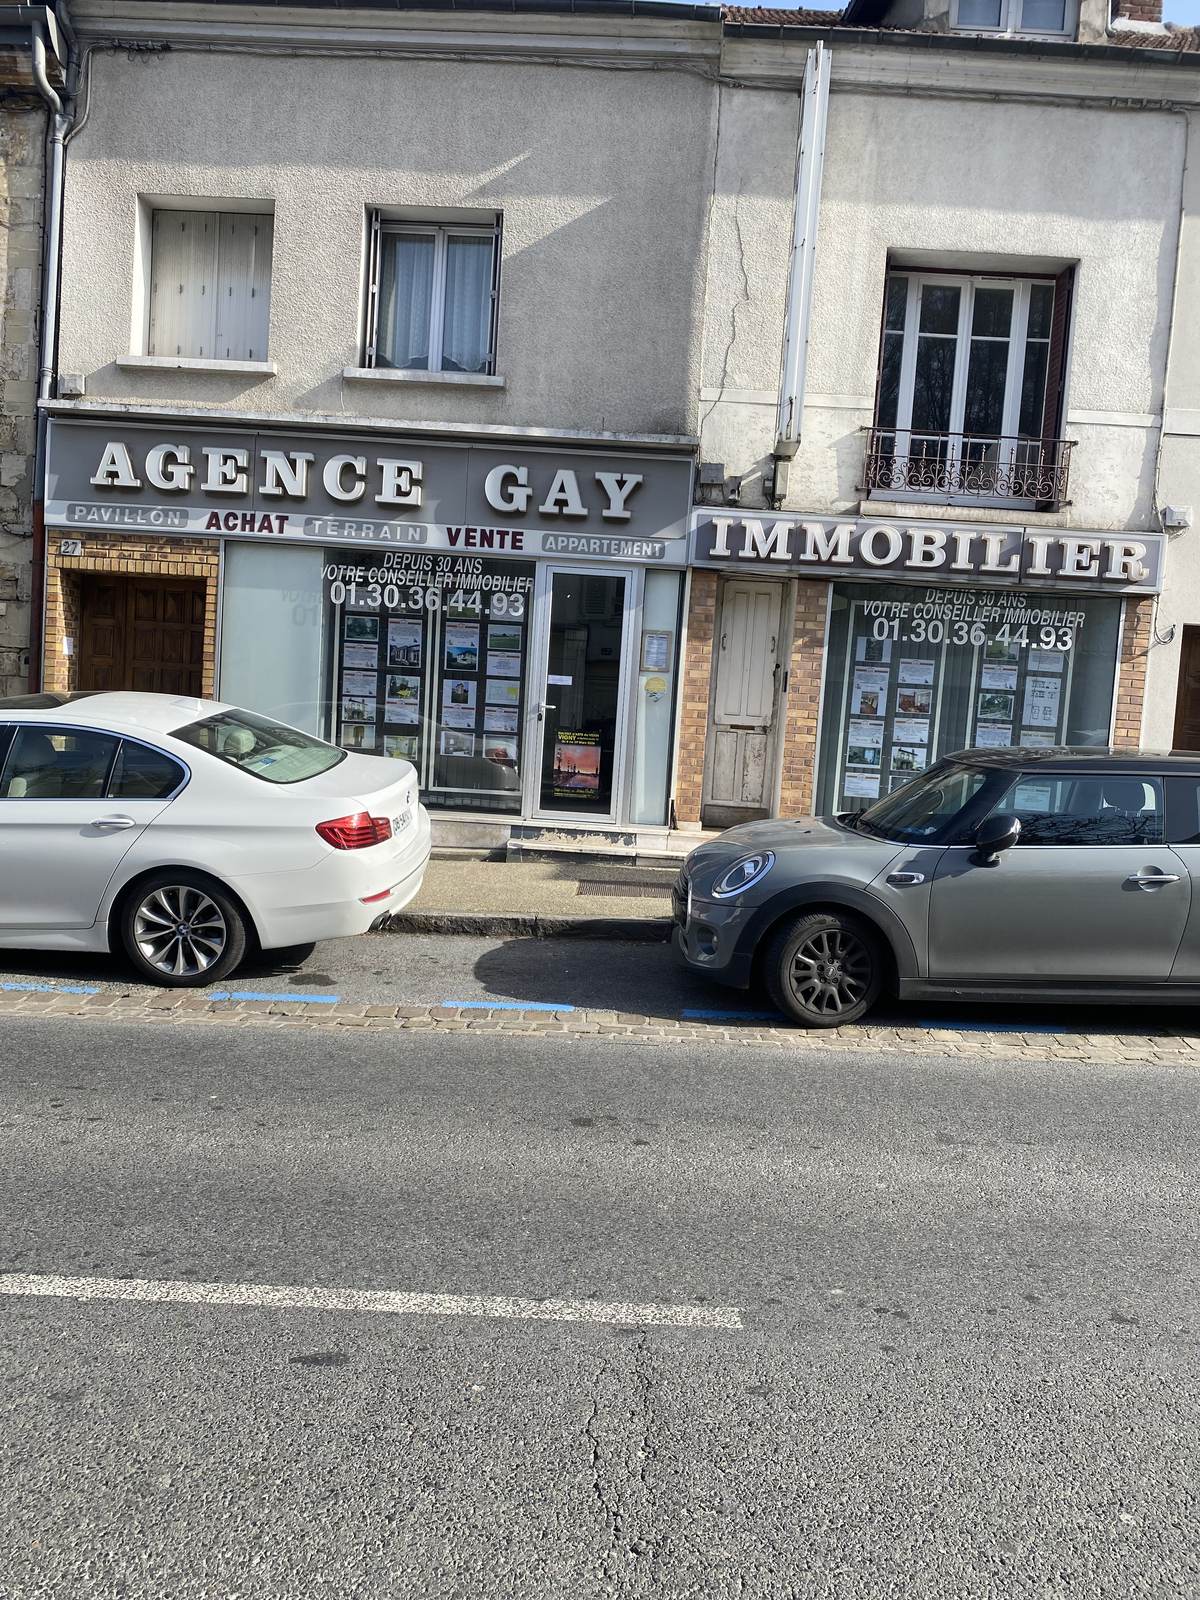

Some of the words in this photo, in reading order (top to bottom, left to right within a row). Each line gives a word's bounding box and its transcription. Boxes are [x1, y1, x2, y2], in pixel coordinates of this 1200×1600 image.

[89, 441, 423, 507] AGENCE
[484, 464, 644, 519] GAY
[73, 506, 181, 525] PAVILLON
[205, 511, 289, 535] ACHAT
[311, 518, 422, 541] TERRAIN
[447, 527, 524, 550] VENTE
[62, 541, 78, 554] 27
[544, 536, 664, 558] APPARTEMENT
[709, 516, 1150, 582] IMMOBILIER
[383, 552, 432, 571] DEPUIS
[436, 556, 451, 572] 30
[454, 558, 483, 574] ANS
[321, 564, 365, 582] VOTRE
[368, 567, 452, 588] CONSEILLER
[455, 574, 534, 593] IMMOBILIER
[330, 581, 525, 617] 01.30.36.44.93
[925, 588, 976, 605] DEPUIS
[979, 591, 995, 607] 30
[998, 591, 1028, 608] ANS
[863, 600, 909, 618] VOTRE
[913, 603, 1000, 623] CONSEILLER
[1003, 608, 1086, 628] IMMOBILIER
[873, 617, 1073, 651] 01.30.36.44.93
